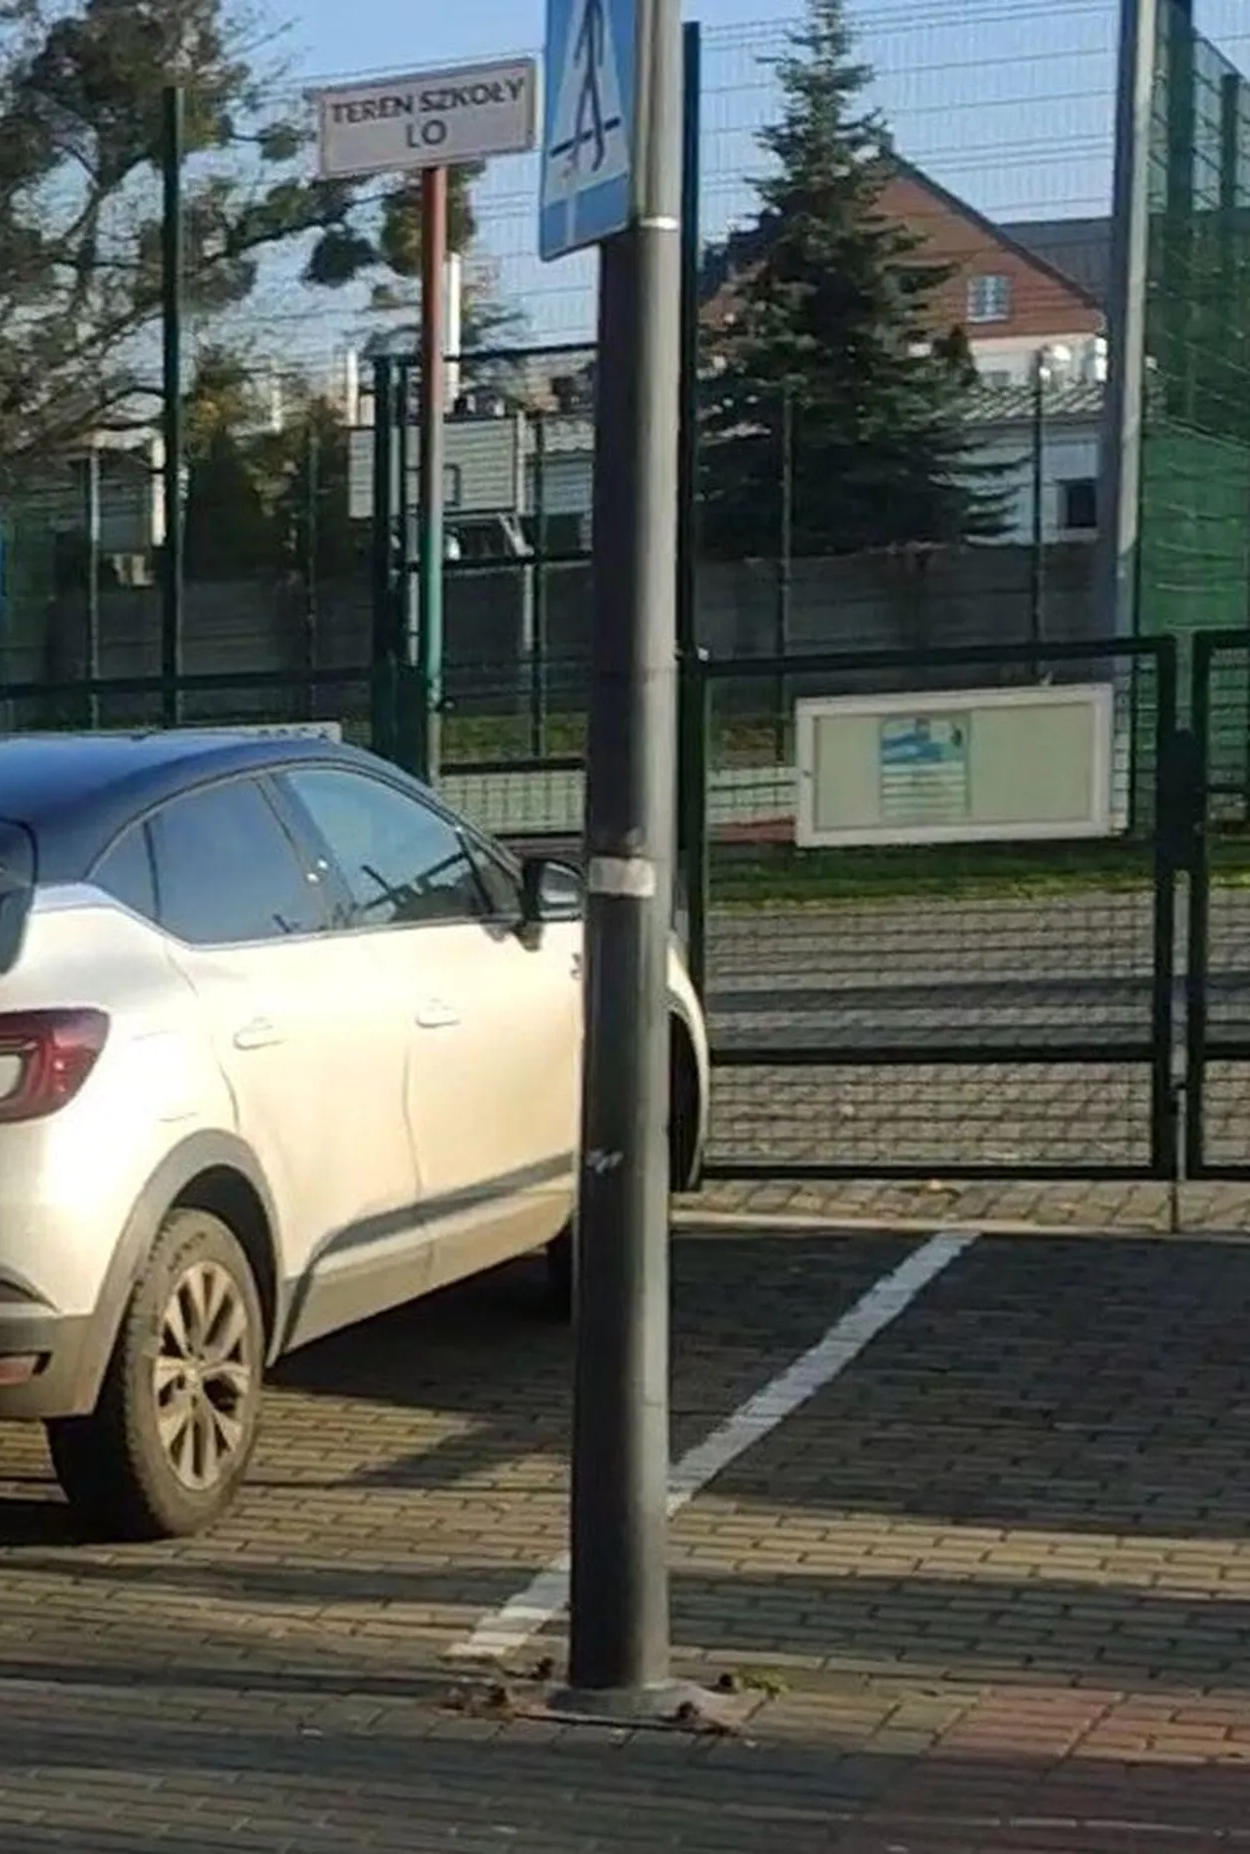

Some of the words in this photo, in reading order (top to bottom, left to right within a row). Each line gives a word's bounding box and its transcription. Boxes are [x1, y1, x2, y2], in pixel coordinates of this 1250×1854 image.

[330, 94, 413, 124] TEREN
[419, 77, 525, 113] SZKOŁY
[405, 118, 448, 149] LO
